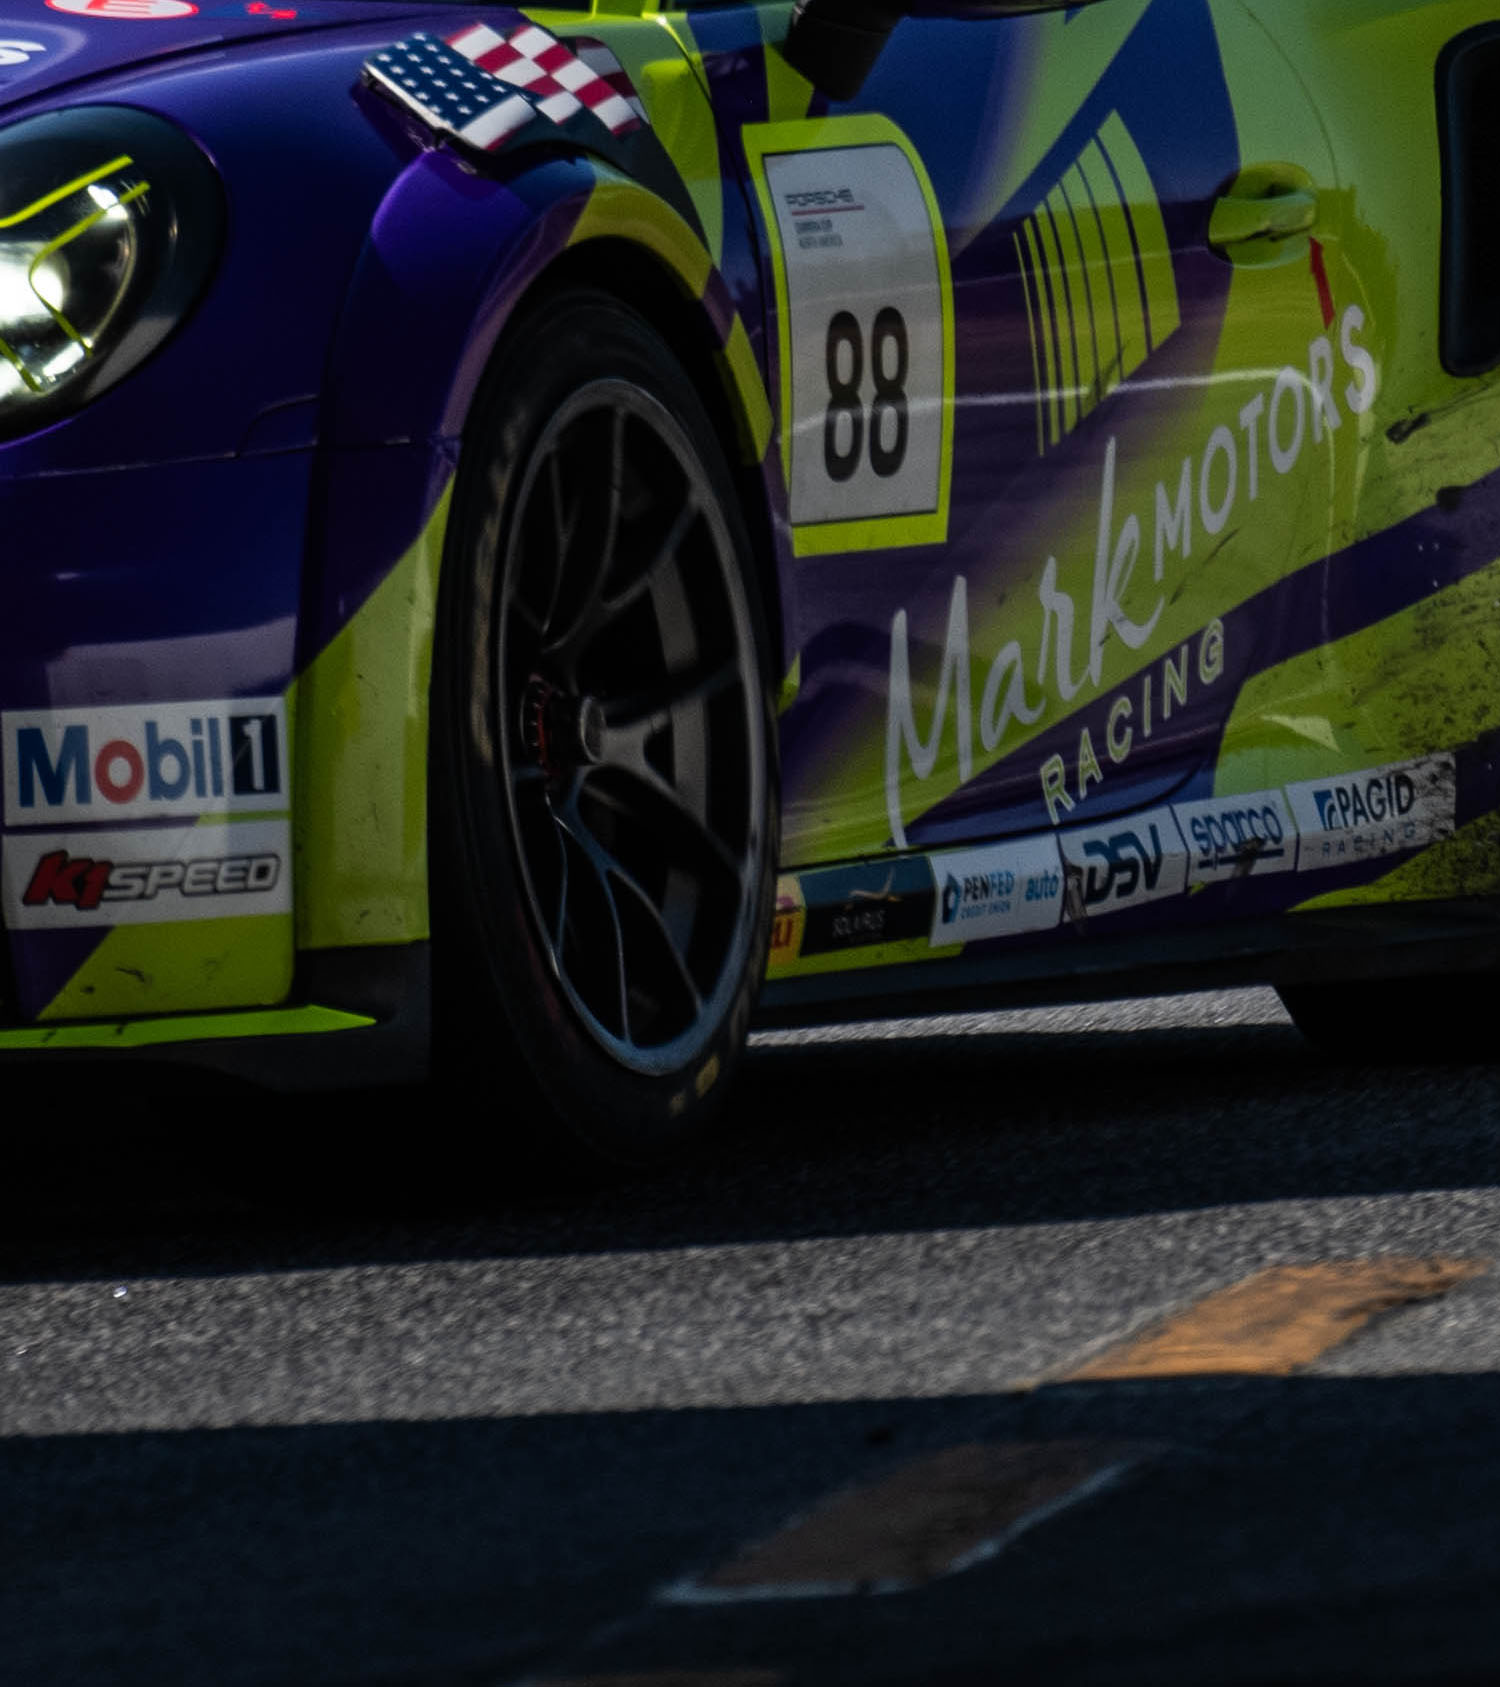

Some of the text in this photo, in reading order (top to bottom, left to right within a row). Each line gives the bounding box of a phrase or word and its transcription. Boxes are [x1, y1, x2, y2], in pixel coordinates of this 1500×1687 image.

[823, 305, 910, 483] 88
[885, 435, 1165, 849] Mark
[1153, 304, 1381, 584] MOTORS
[16, 717, 268, 809] Mobil 1
[1040, 617, 1226, 825] RACING
[1191, 803, 1285, 857] sparco
[1335, 770, 1416, 831] PAGID
[963, 871, 1017, 902] PENFED
[1024, 872, 1060, 902] auto
[1082, 821, 1164, 905] DSV
